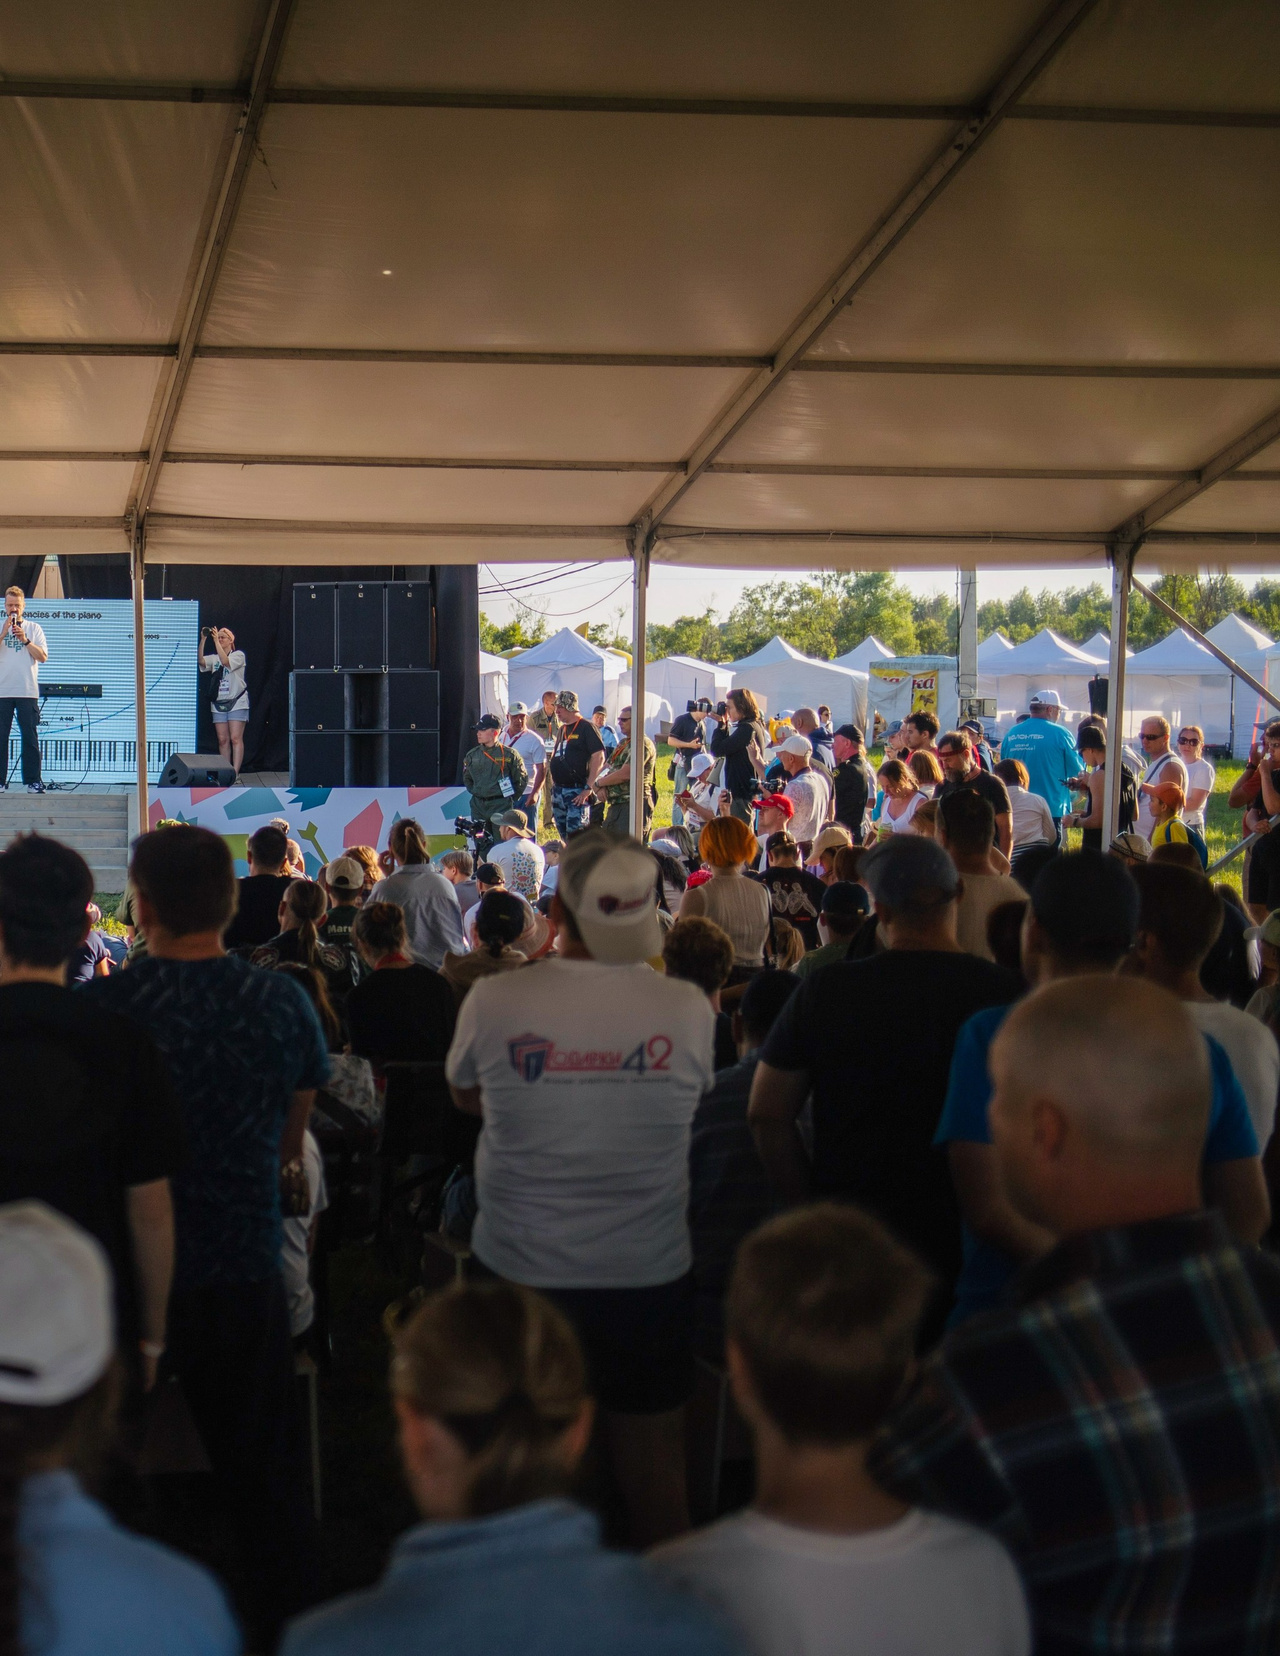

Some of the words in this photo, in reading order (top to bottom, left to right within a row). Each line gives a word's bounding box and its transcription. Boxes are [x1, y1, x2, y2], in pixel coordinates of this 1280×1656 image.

[0, 610, 50, 619] frencies
[52, 611, 61, 619] of
[62, 611, 76, 619] the
[78, 612, 103, 620] piano
